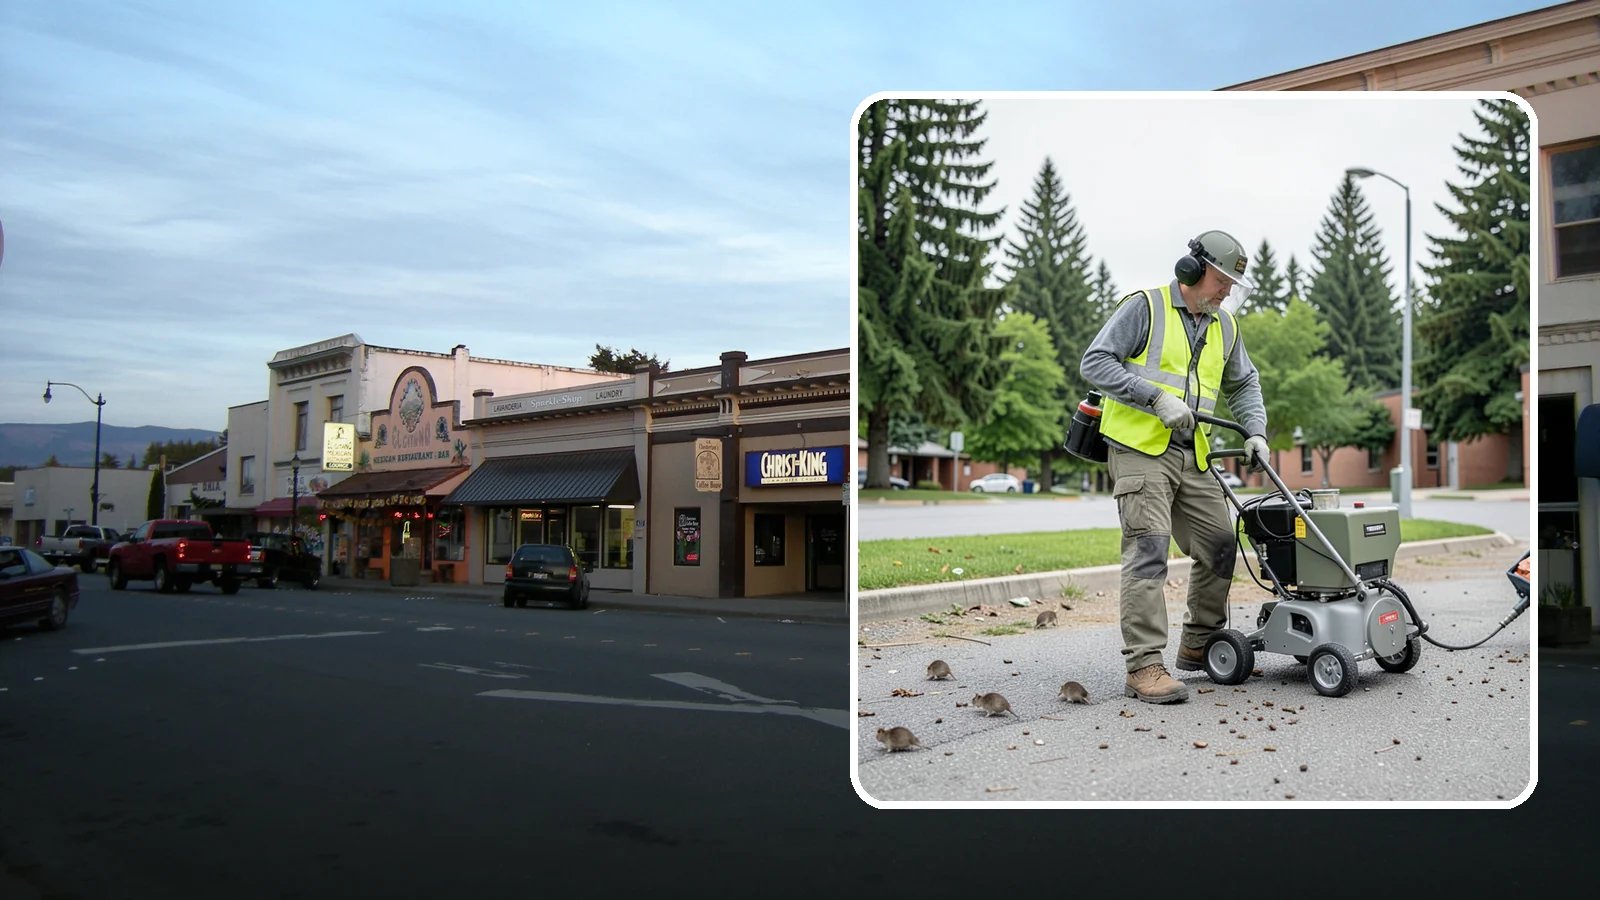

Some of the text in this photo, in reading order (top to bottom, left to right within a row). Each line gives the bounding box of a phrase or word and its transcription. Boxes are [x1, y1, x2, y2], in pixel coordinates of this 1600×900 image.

[596, 389, 623, 399] LAUNDRY
[561, 395, 582, 406] Shop
[493, 402, 522, 412] LAVANDERIA
[397, 451, 433, 462] RESTAURANT
[438, 450, 450, 459] BAR
[761, 450, 827, 478] CHRIST KING
